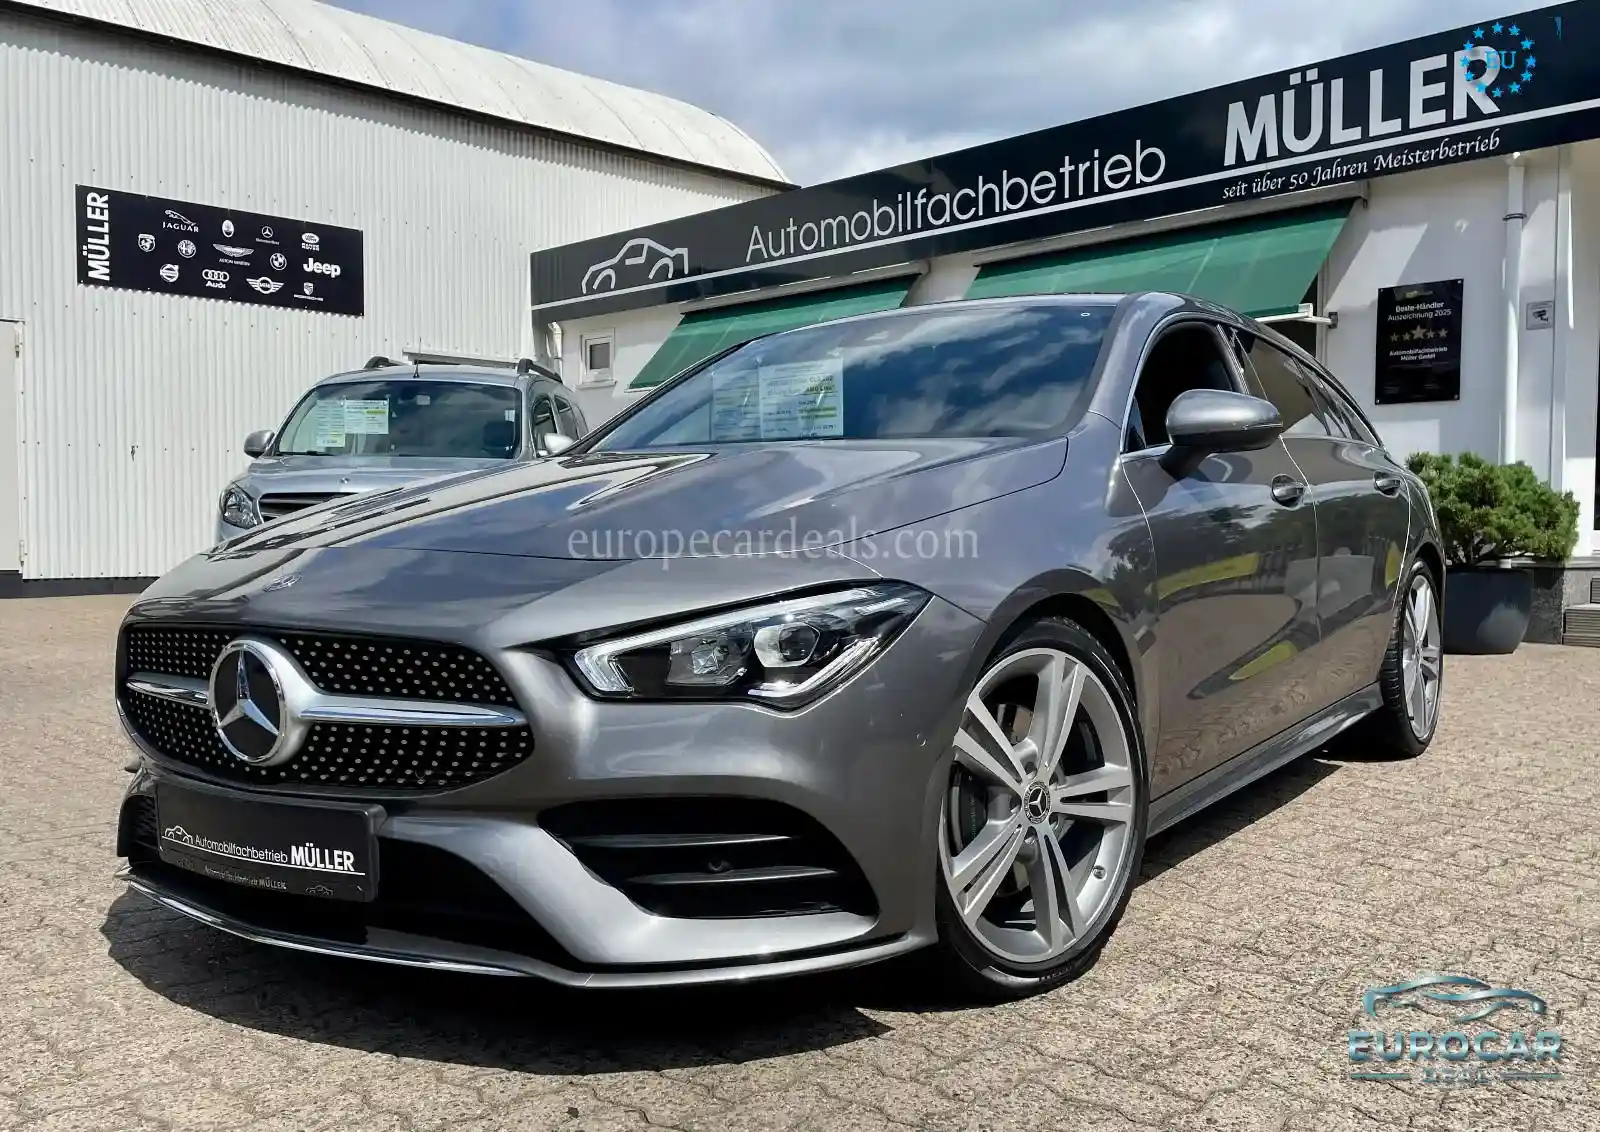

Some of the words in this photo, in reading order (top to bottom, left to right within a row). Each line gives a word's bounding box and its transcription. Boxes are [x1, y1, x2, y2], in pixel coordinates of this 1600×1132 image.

[745, 139, 1166, 262] Automobilfachbetrieb
[1223, 45, 1500, 166] MÜLLER
[1223, 182, 1248, 199] seit
[1252, 172, 1286, 194] über
[1289, 172, 1308, 190] 50
[1311, 161, 1369, 186] Jahren
[1373, 128, 1500, 172] Meisterbetrieb
[83, 192, 110, 281] MÜLLER
[162, 221, 199, 233] JAGUAR
[206, 281, 226, 289] Audi
[303, 257, 341, 279] Jeep
[195, 834, 288, 864] Automobilfachbetrieb
[291, 843, 355, 872] MÜLLER
